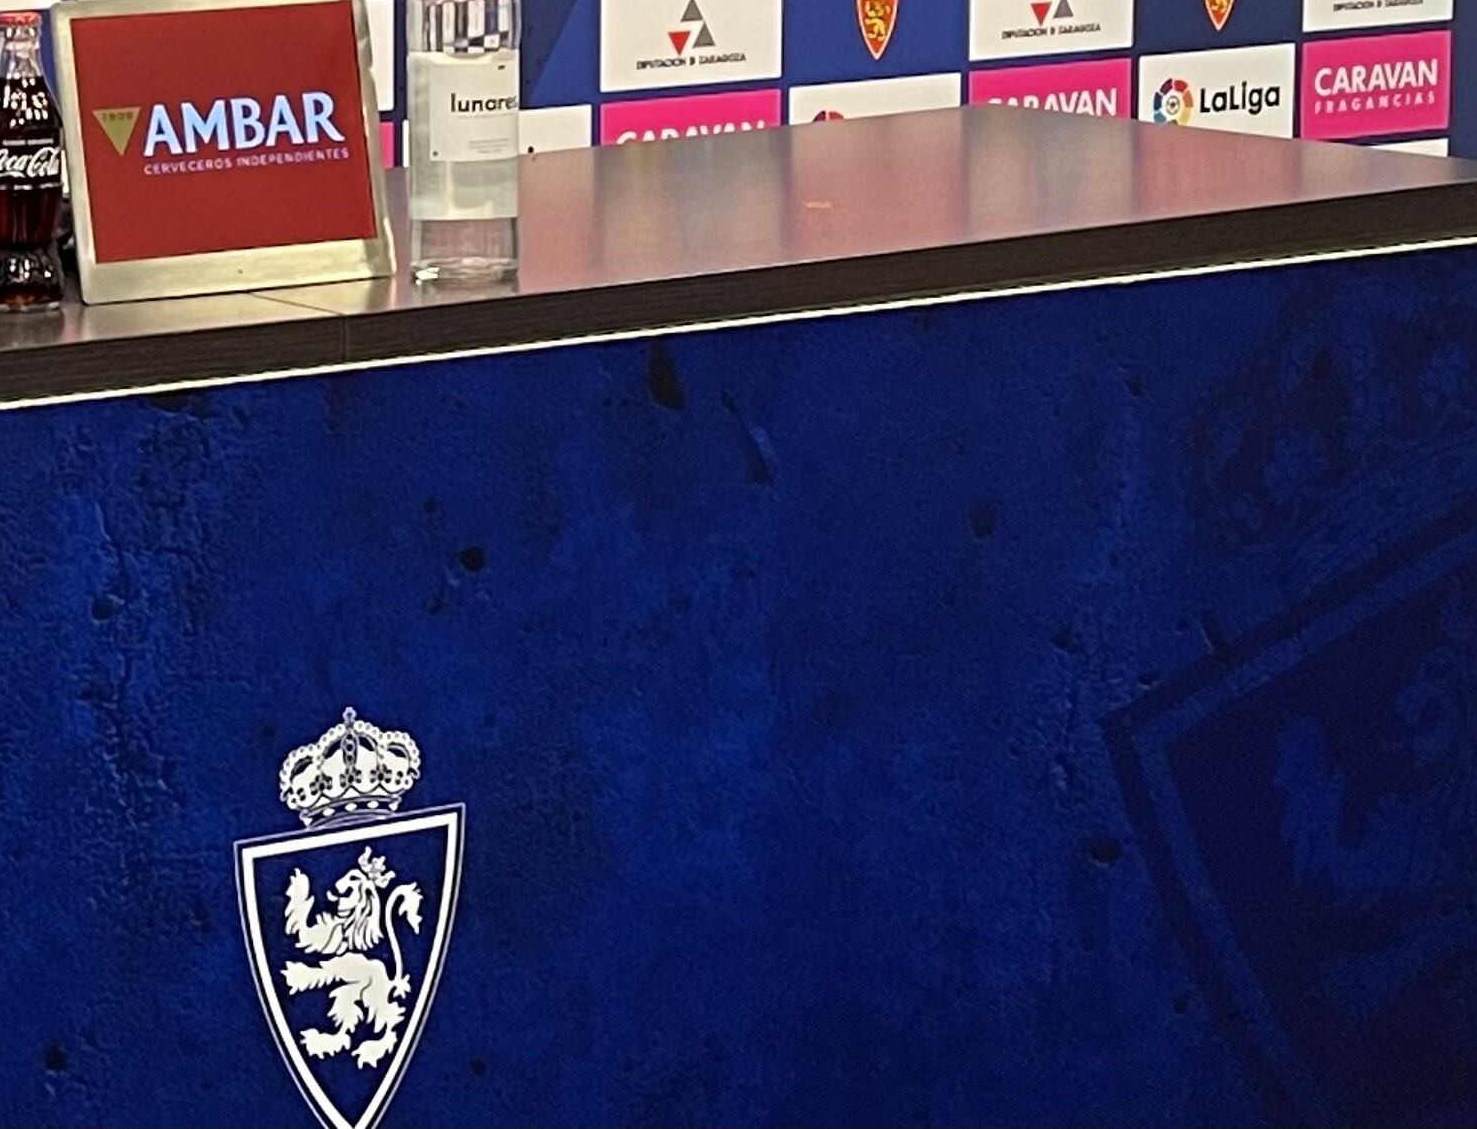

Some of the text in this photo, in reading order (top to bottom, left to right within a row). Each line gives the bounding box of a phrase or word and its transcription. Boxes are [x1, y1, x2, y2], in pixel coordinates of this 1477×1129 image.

[1314, 58, 1438, 98] CARAVAN
[1199, 80, 1281, 116] LaLiga
[143, 91, 346, 158] AMBAR
[143, 147, 350, 176] CERVECEROS INDEPENDIENTES
